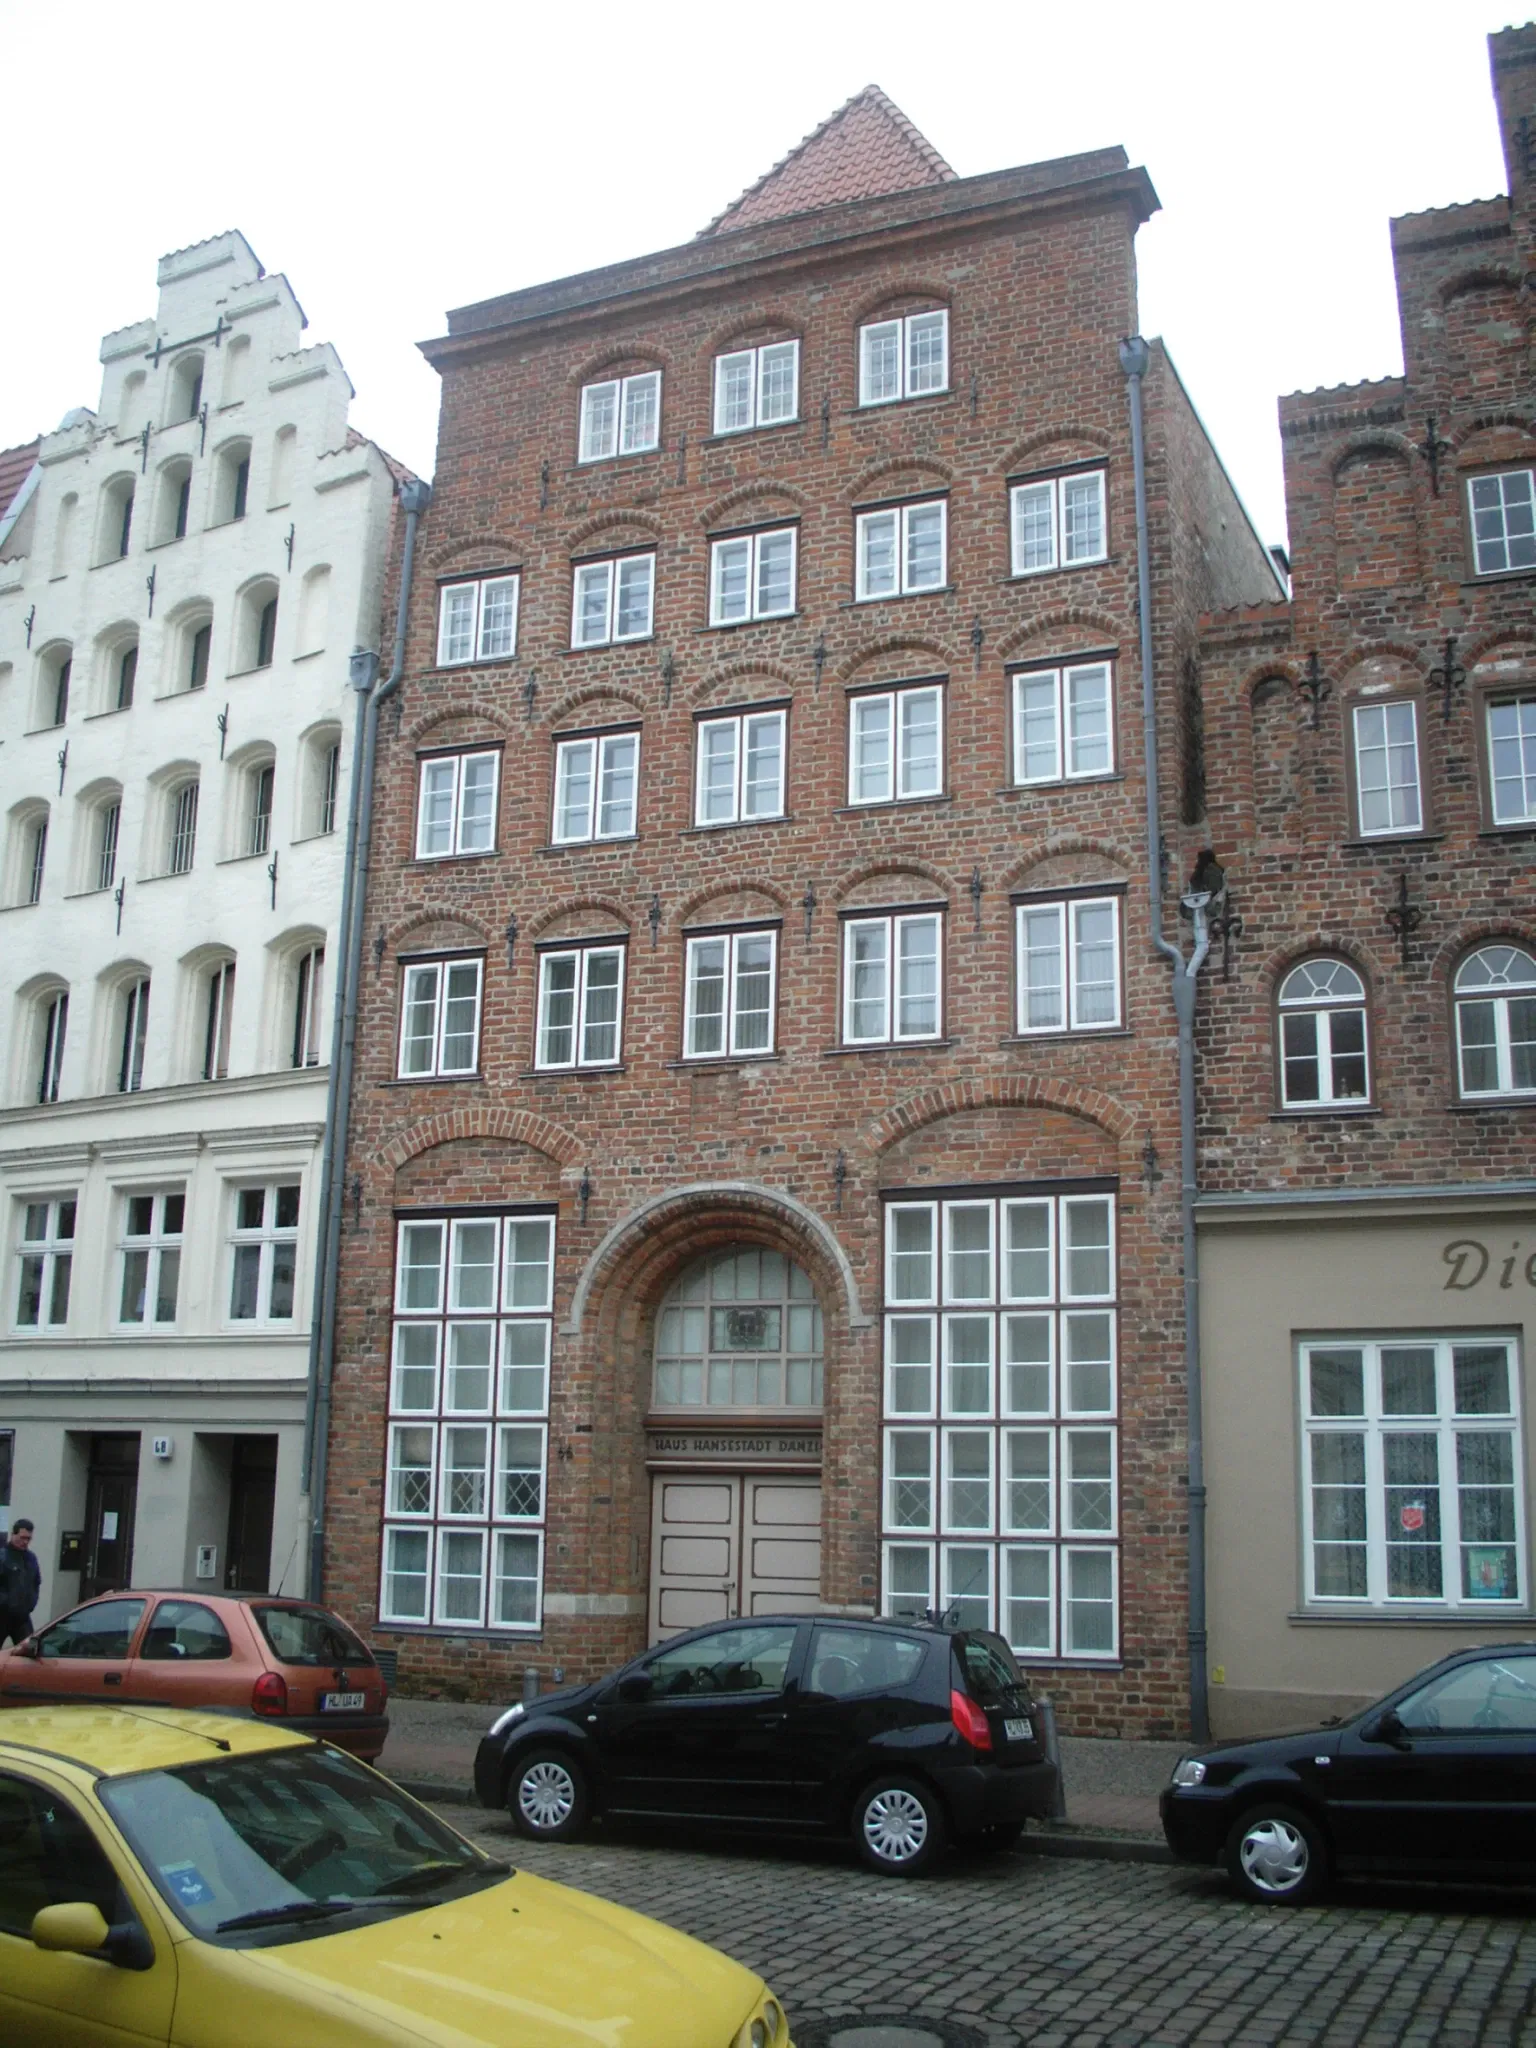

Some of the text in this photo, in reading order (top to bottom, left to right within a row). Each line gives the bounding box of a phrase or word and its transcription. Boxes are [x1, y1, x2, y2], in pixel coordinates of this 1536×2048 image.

[655, 1439, 823, 1453] HAUS HANSESTADT DANZI
